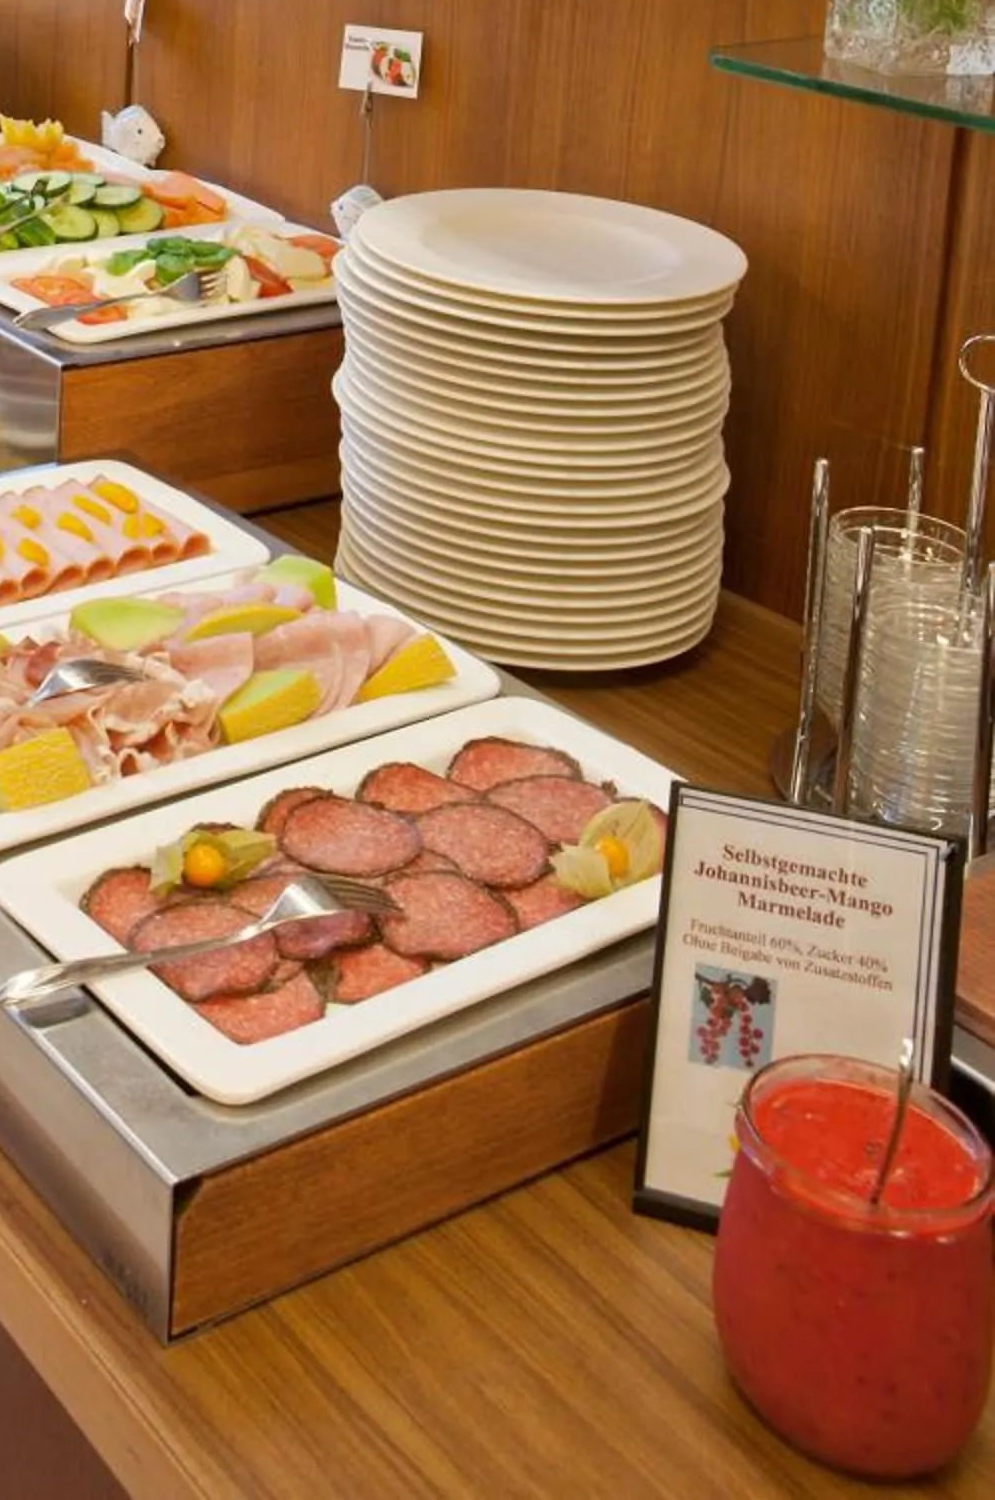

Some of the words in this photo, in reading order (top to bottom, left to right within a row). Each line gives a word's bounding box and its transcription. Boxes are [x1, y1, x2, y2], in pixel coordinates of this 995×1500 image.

[694, 861, 894, 918] Johannisbeer-Mango
[723, 844, 869, 889] Selbstgemachte
[737, 891, 846, 929] Marmelade
[682, 932, 718, 952] Ohne
[720, 940, 774, 965] Beigabe
[775, 955, 802, 971] von
[804, 961, 894, 992] Zusatzstoffen
[690, 918, 767, 947] Fruchtanteil
[806, 945, 853, 966] Zucker
